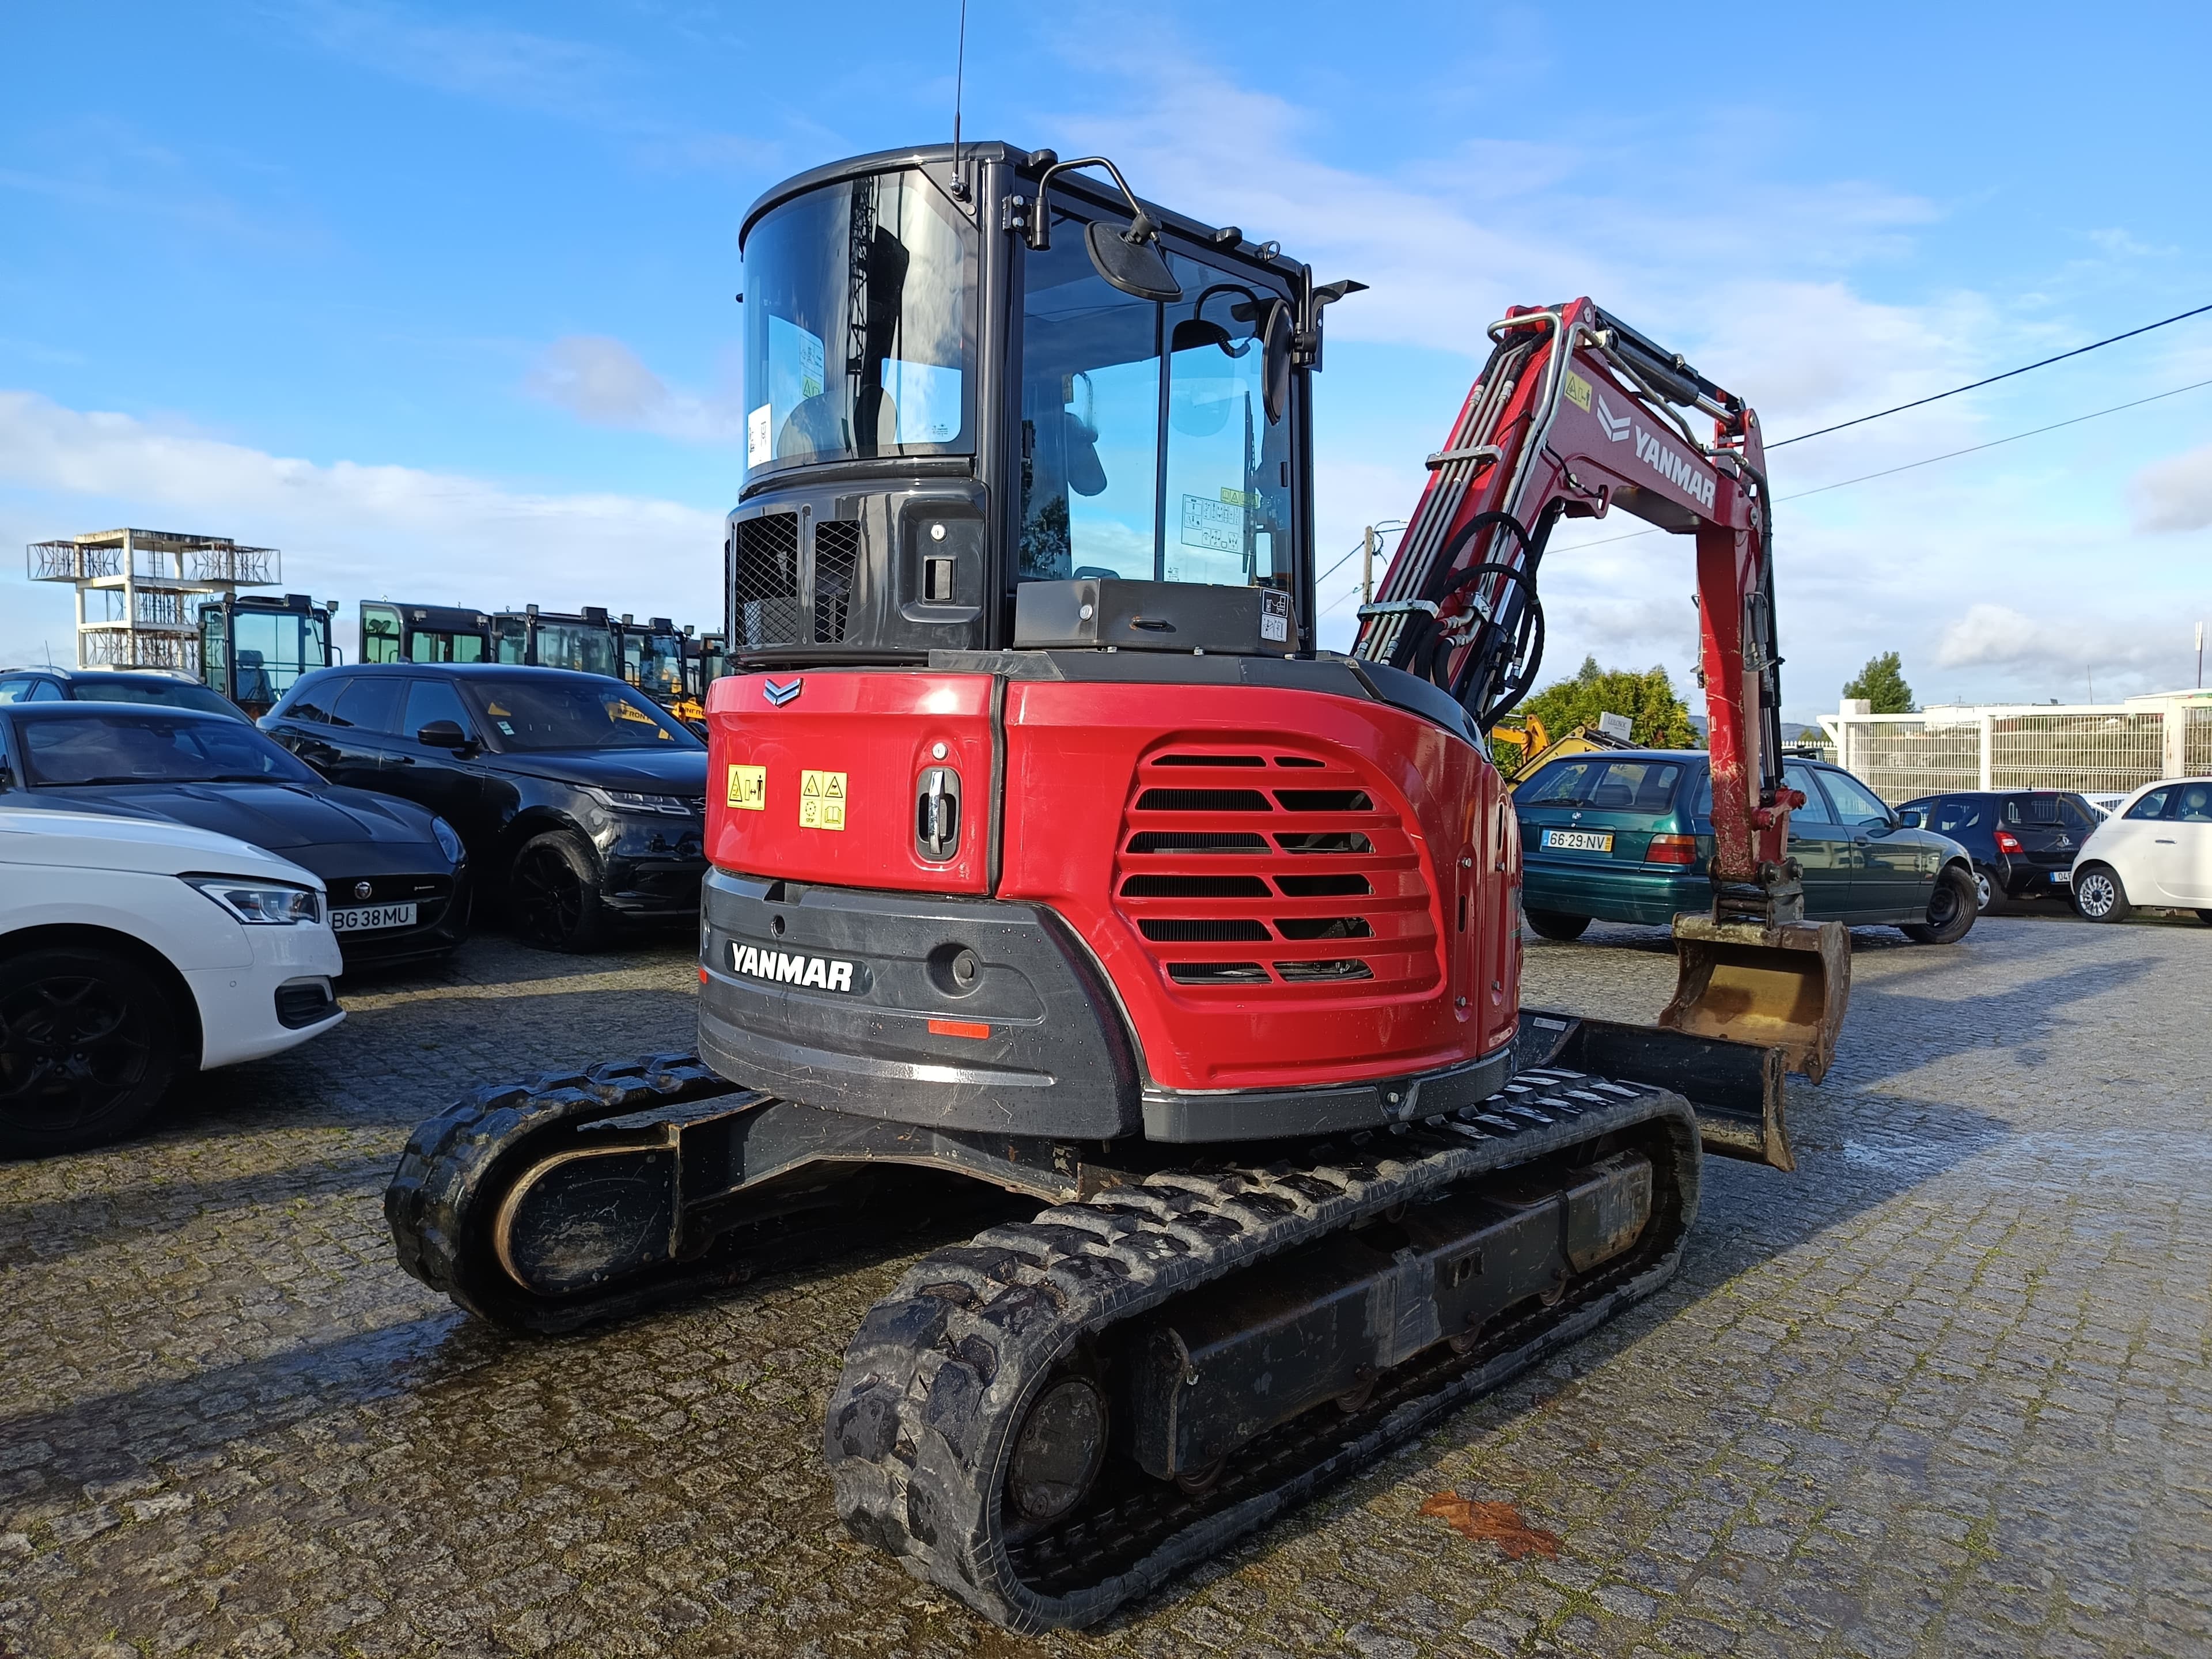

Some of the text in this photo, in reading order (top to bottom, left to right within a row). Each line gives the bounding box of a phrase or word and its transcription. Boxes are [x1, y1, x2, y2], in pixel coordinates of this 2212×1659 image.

[1635, 425, 1715, 509] YANMAR
[332, 907, 408, 929] BG 38 MU
[732, 942, 853, 992] YANMAR
